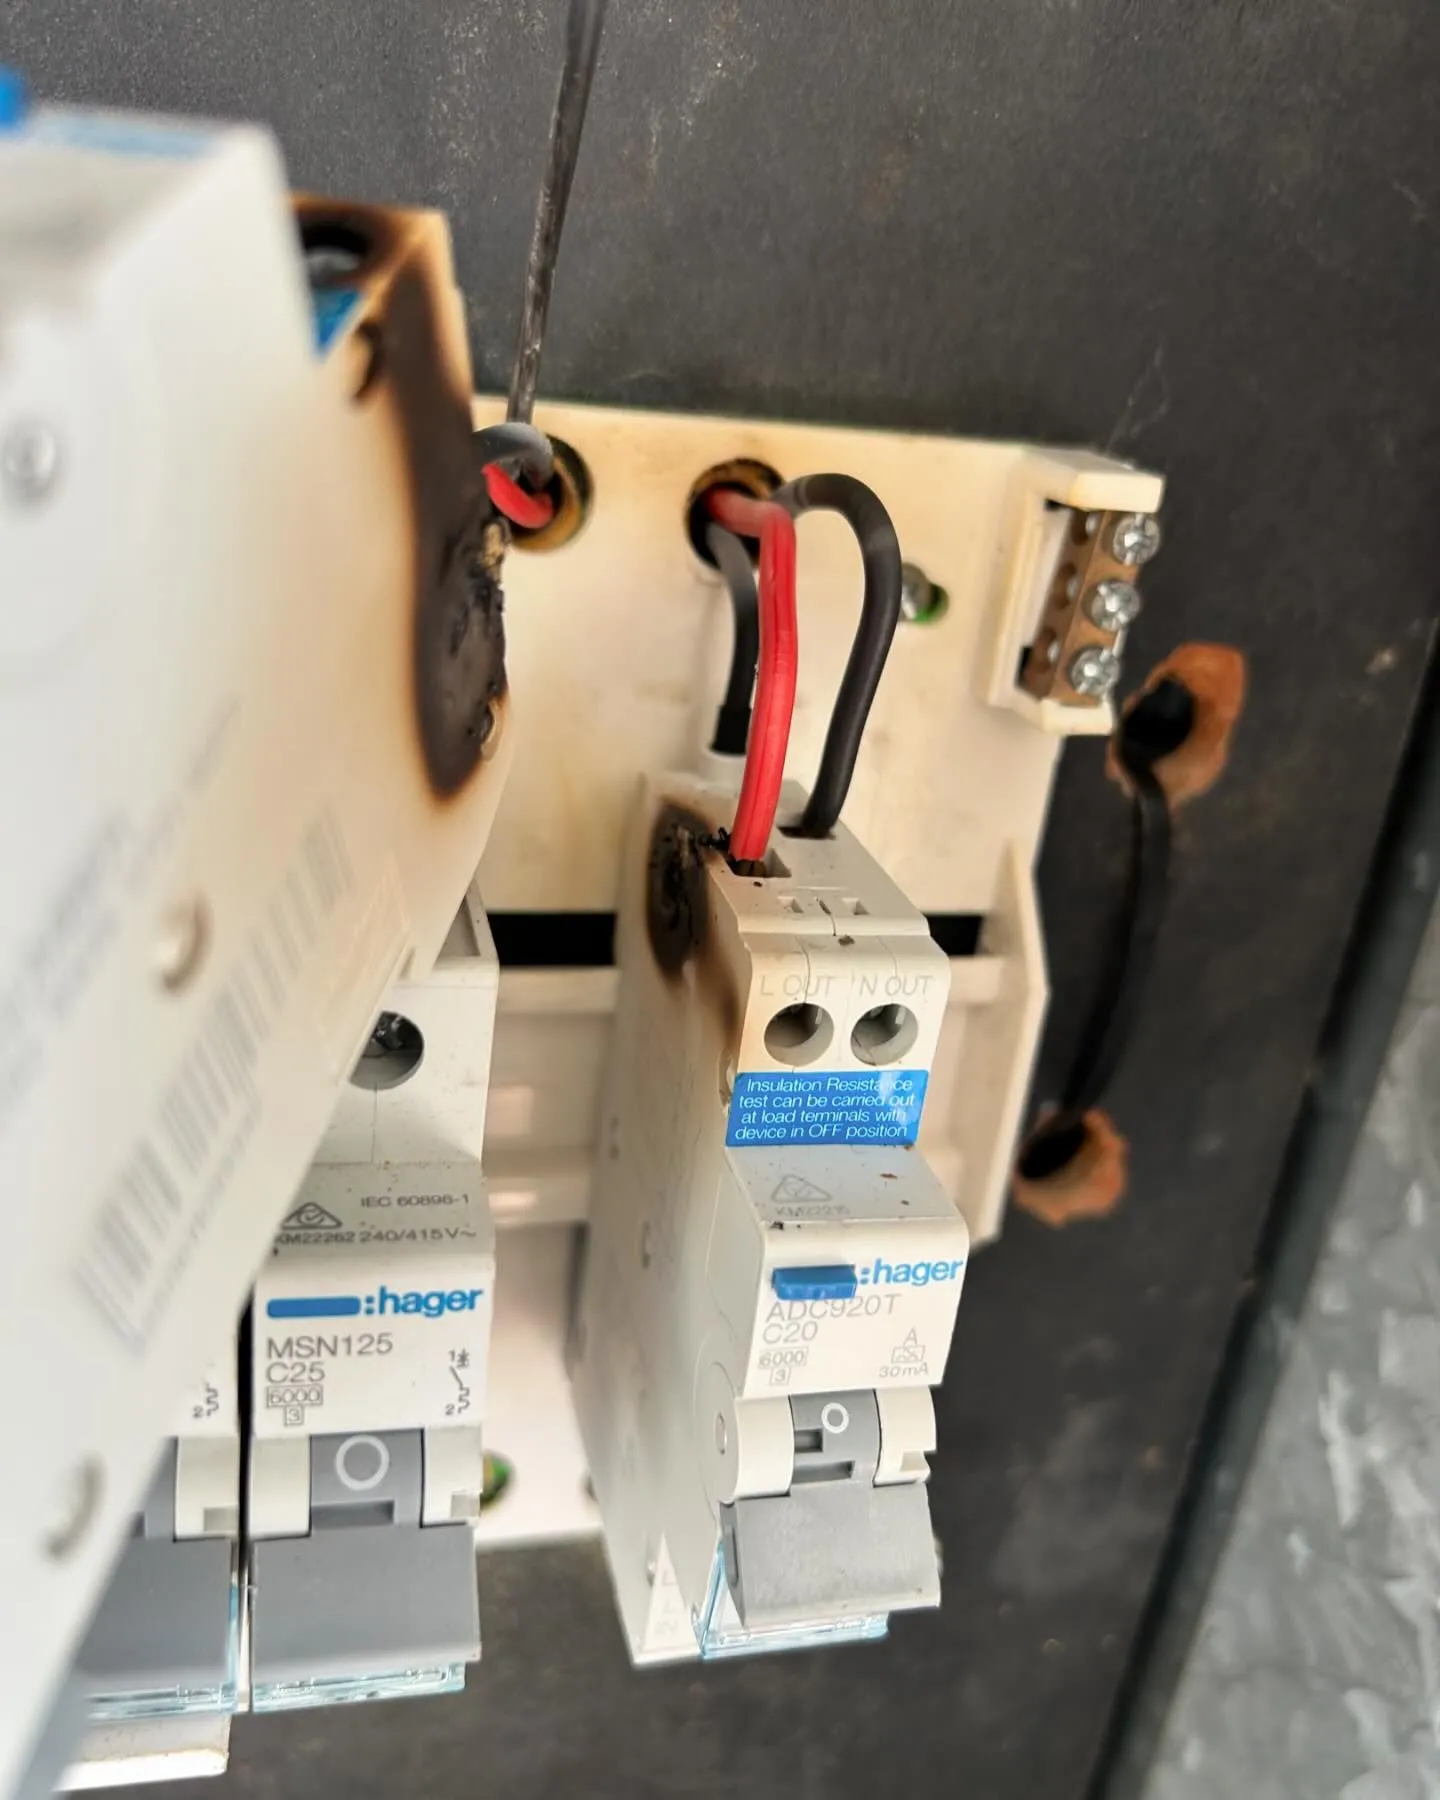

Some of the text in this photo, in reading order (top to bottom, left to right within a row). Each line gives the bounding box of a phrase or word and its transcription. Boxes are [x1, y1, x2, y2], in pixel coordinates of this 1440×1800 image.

[783, 974, 835, 997] OUT
[884, 973, 934, 996] OUT
[746, 1078, 827, 1093] Insulation
[739, 1093, 768, 1108] test
[772, 1096, 803, 1109] can
[807, 1093, 828, 1109] be
[889, 1092, 916, 1107] out
[740, 1110, 758, 1124] at
[761, 1109, 797, 1124] load
[800, 1107, 870, 1123] terminals
[735, 1122, 909, 1140] device in OFF position
[361, 1196, 392, 1208] IEC
[765, 1293, 904, 1323] ADC920T
[762, 1320, 819, 1345] C20
[266, 1332, 394, 1360] MSN125
[759, 1351, 805, 1368] 6000
[265, 1361, 326, 1384] C25
[270, 1387, 321, 1404] 6000
